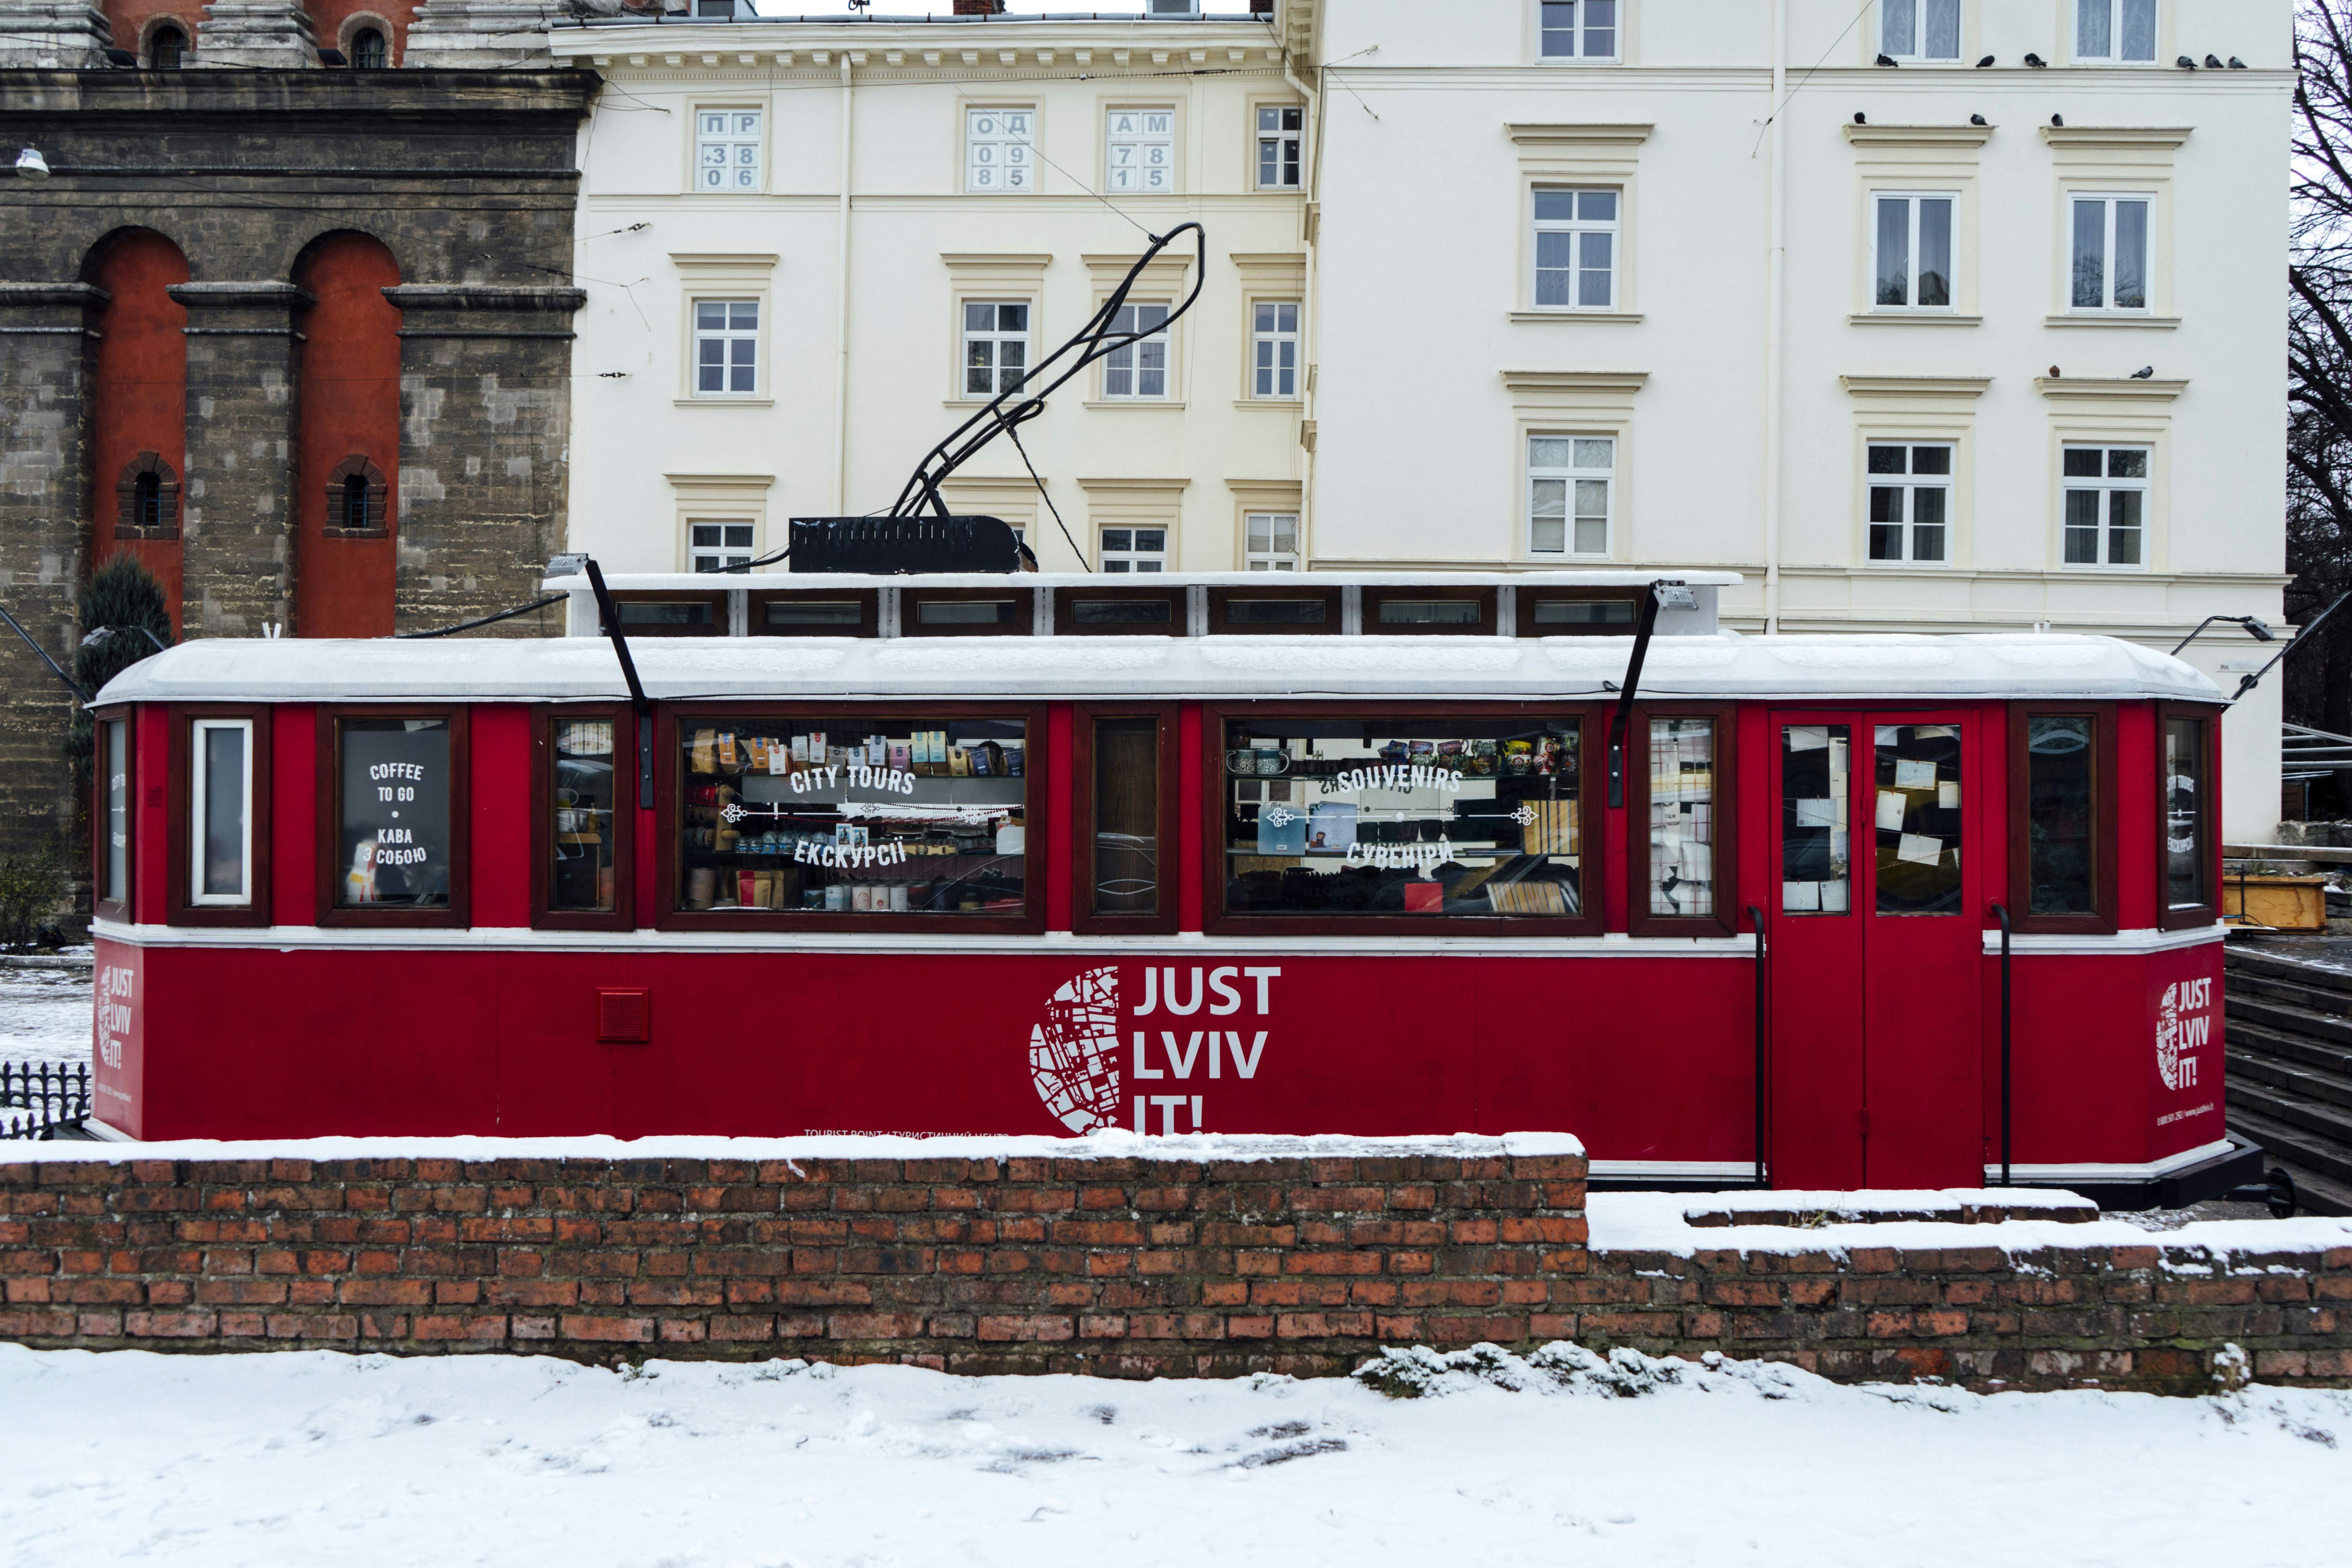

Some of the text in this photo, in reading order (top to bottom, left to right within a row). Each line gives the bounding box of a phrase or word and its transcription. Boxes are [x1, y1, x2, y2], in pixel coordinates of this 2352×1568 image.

[370, 763, 424, 780] COFFEE
[790, 766, 916, 795] CITY TOURS
[1337, 765, 1463, 793] SOUVENIRS
[2177, 775, 2194, 793] TOURS
[378, 787, 414, 801] TO GO
[378, 829, 412, 843] КАВА
[794, 835, 906, 868] ЕКСКУРСІЇ
[363, 847, 426, 865] З СОБОЮ
[1347, 841, 1454, 868] СУВЕНІРИ
[111, 967, 134, 998] JUST
[1134, 966, 1281, 1016] JUST
[2179, 977, 2212, 1012] JUST
[111, 1003, 131, 1034] LVIV
[2178, 1015, 2210, 1050] LVIV
[110, 1039, 122, 1070] IT!
[1133, 1031, 1269, 1079] LVIV
[2179, 1056, 2197, 1089] IT!
[1134, 1095, 1203, 1136] IT!
